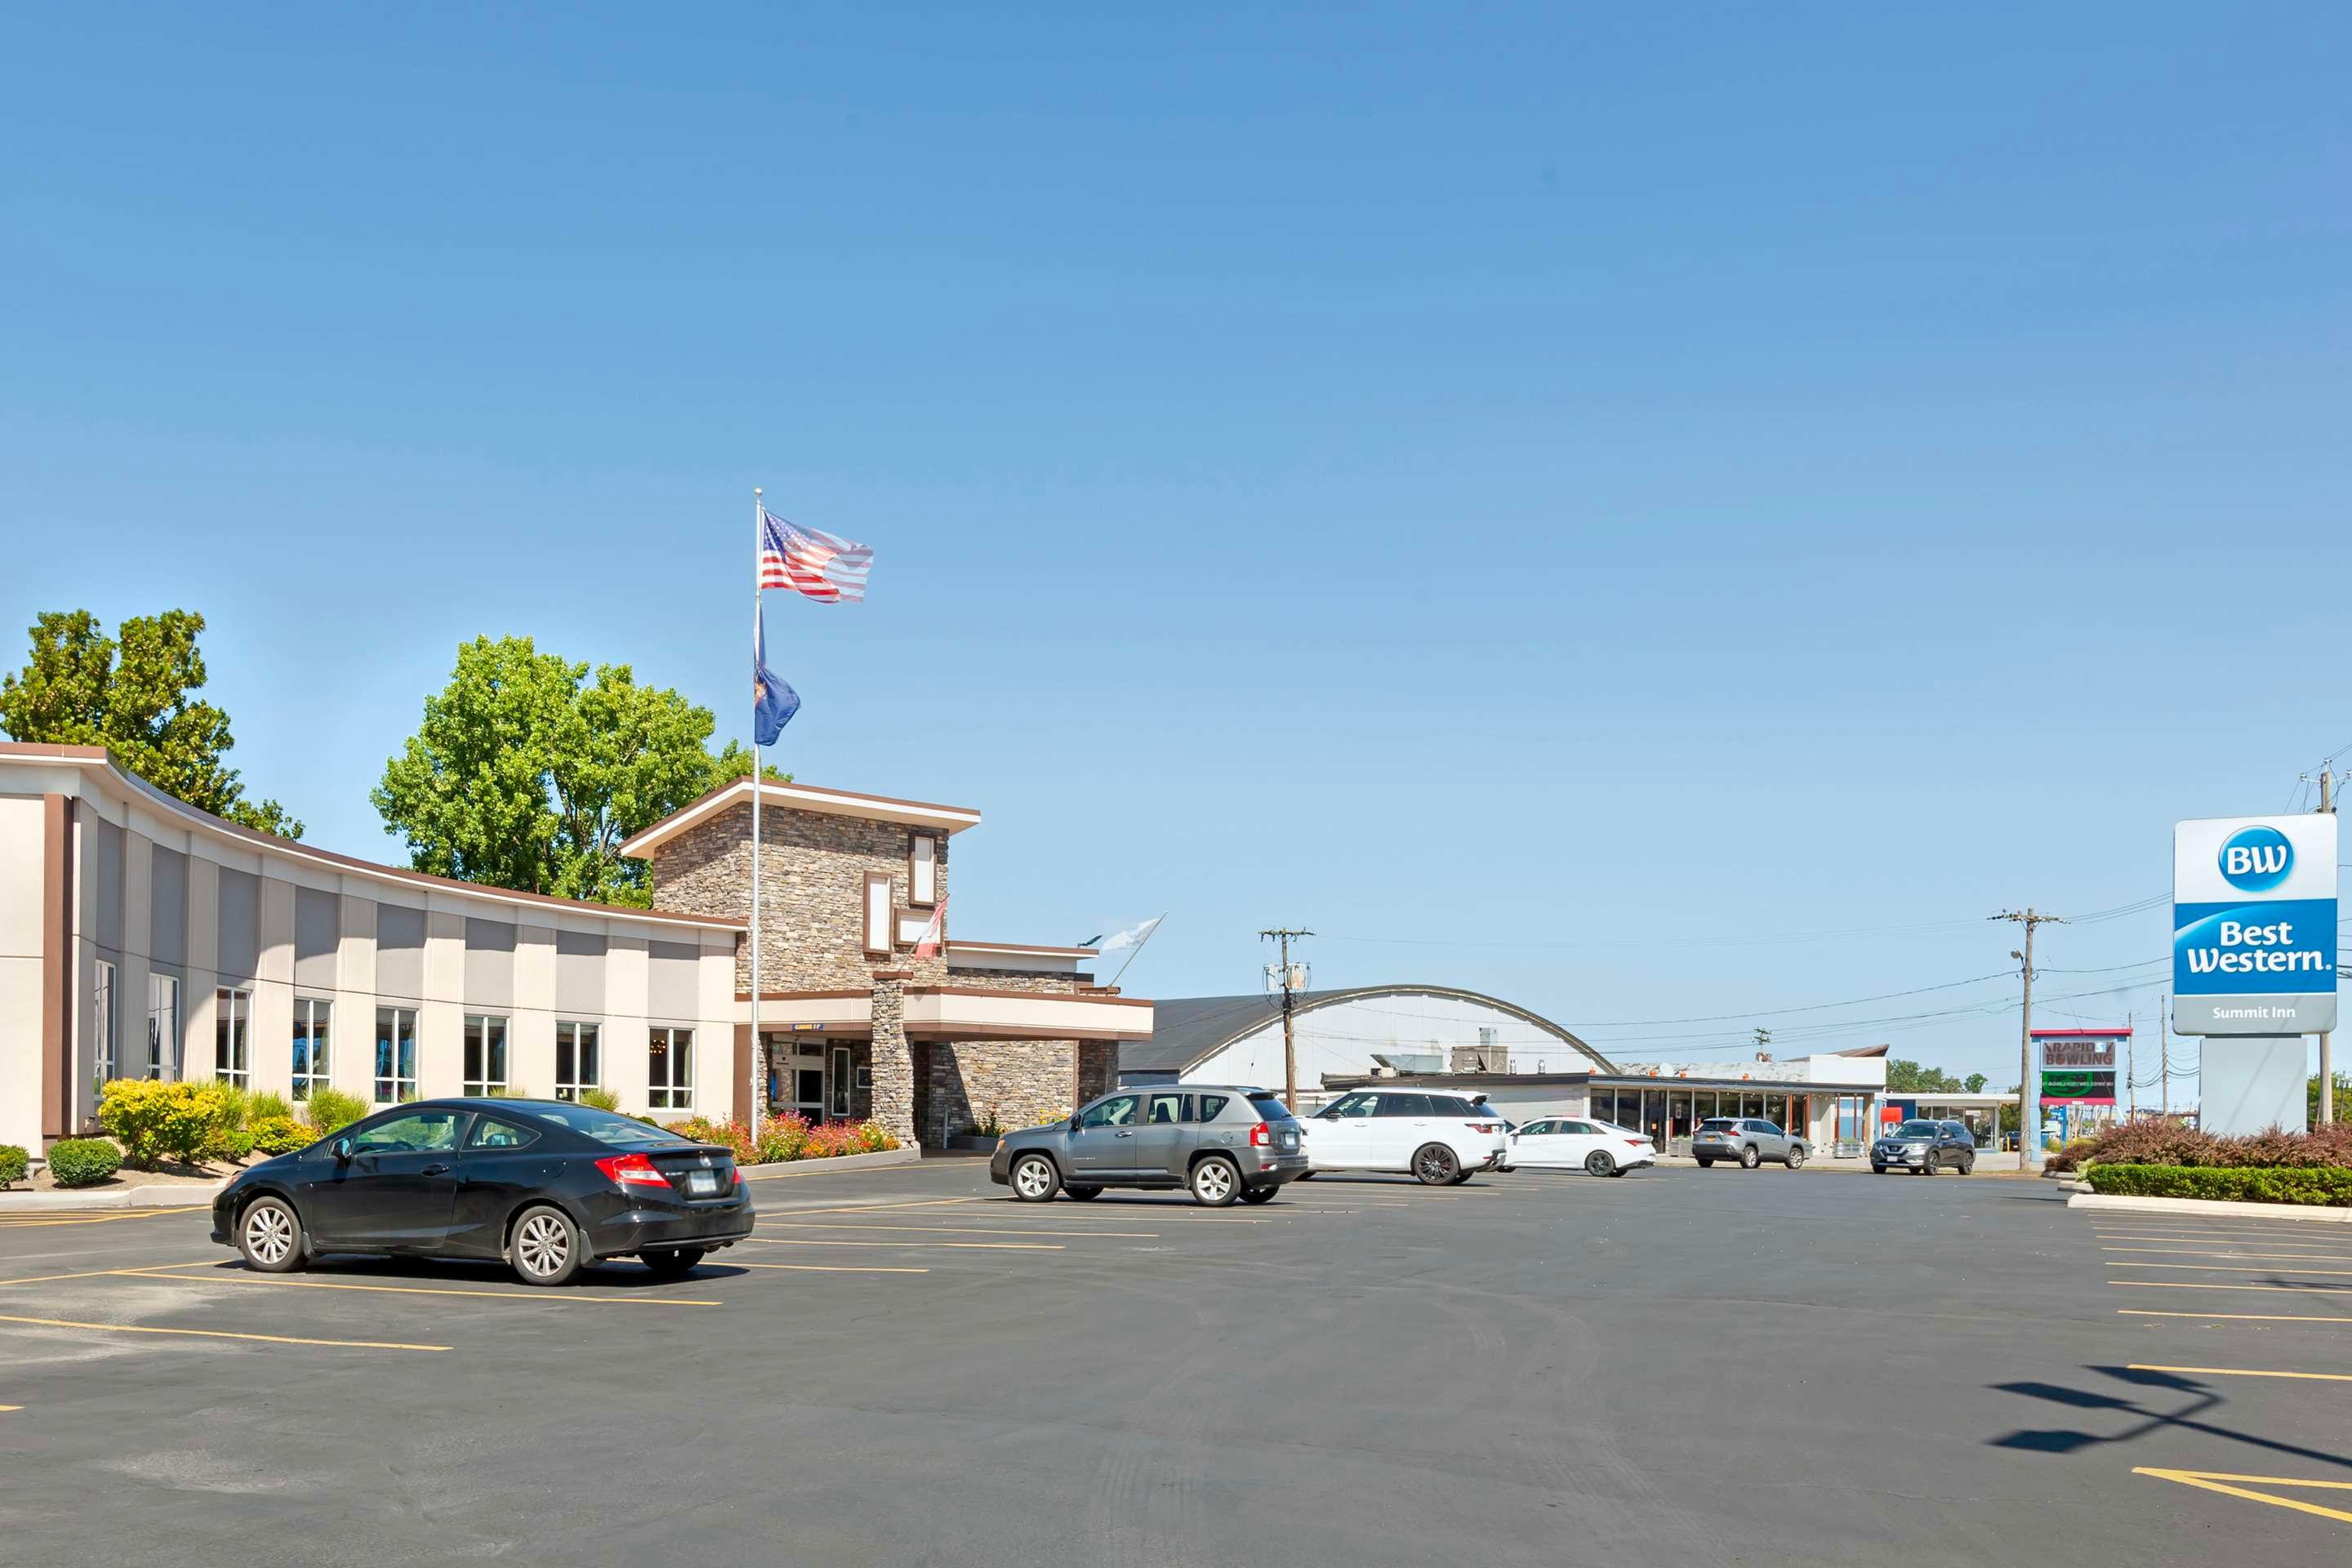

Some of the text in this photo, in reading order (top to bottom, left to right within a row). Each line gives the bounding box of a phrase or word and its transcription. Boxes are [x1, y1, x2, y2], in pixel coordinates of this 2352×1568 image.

[2227, 845, 2287, 875] BW
[2220, 921, 2293, 947] Best
[2212, 1006, 2296, 1019] Summit Inn
[2053, 1042, 2105, 1053] RAPIDS
[2046, 1054, 2113, 1065] BOWLING
